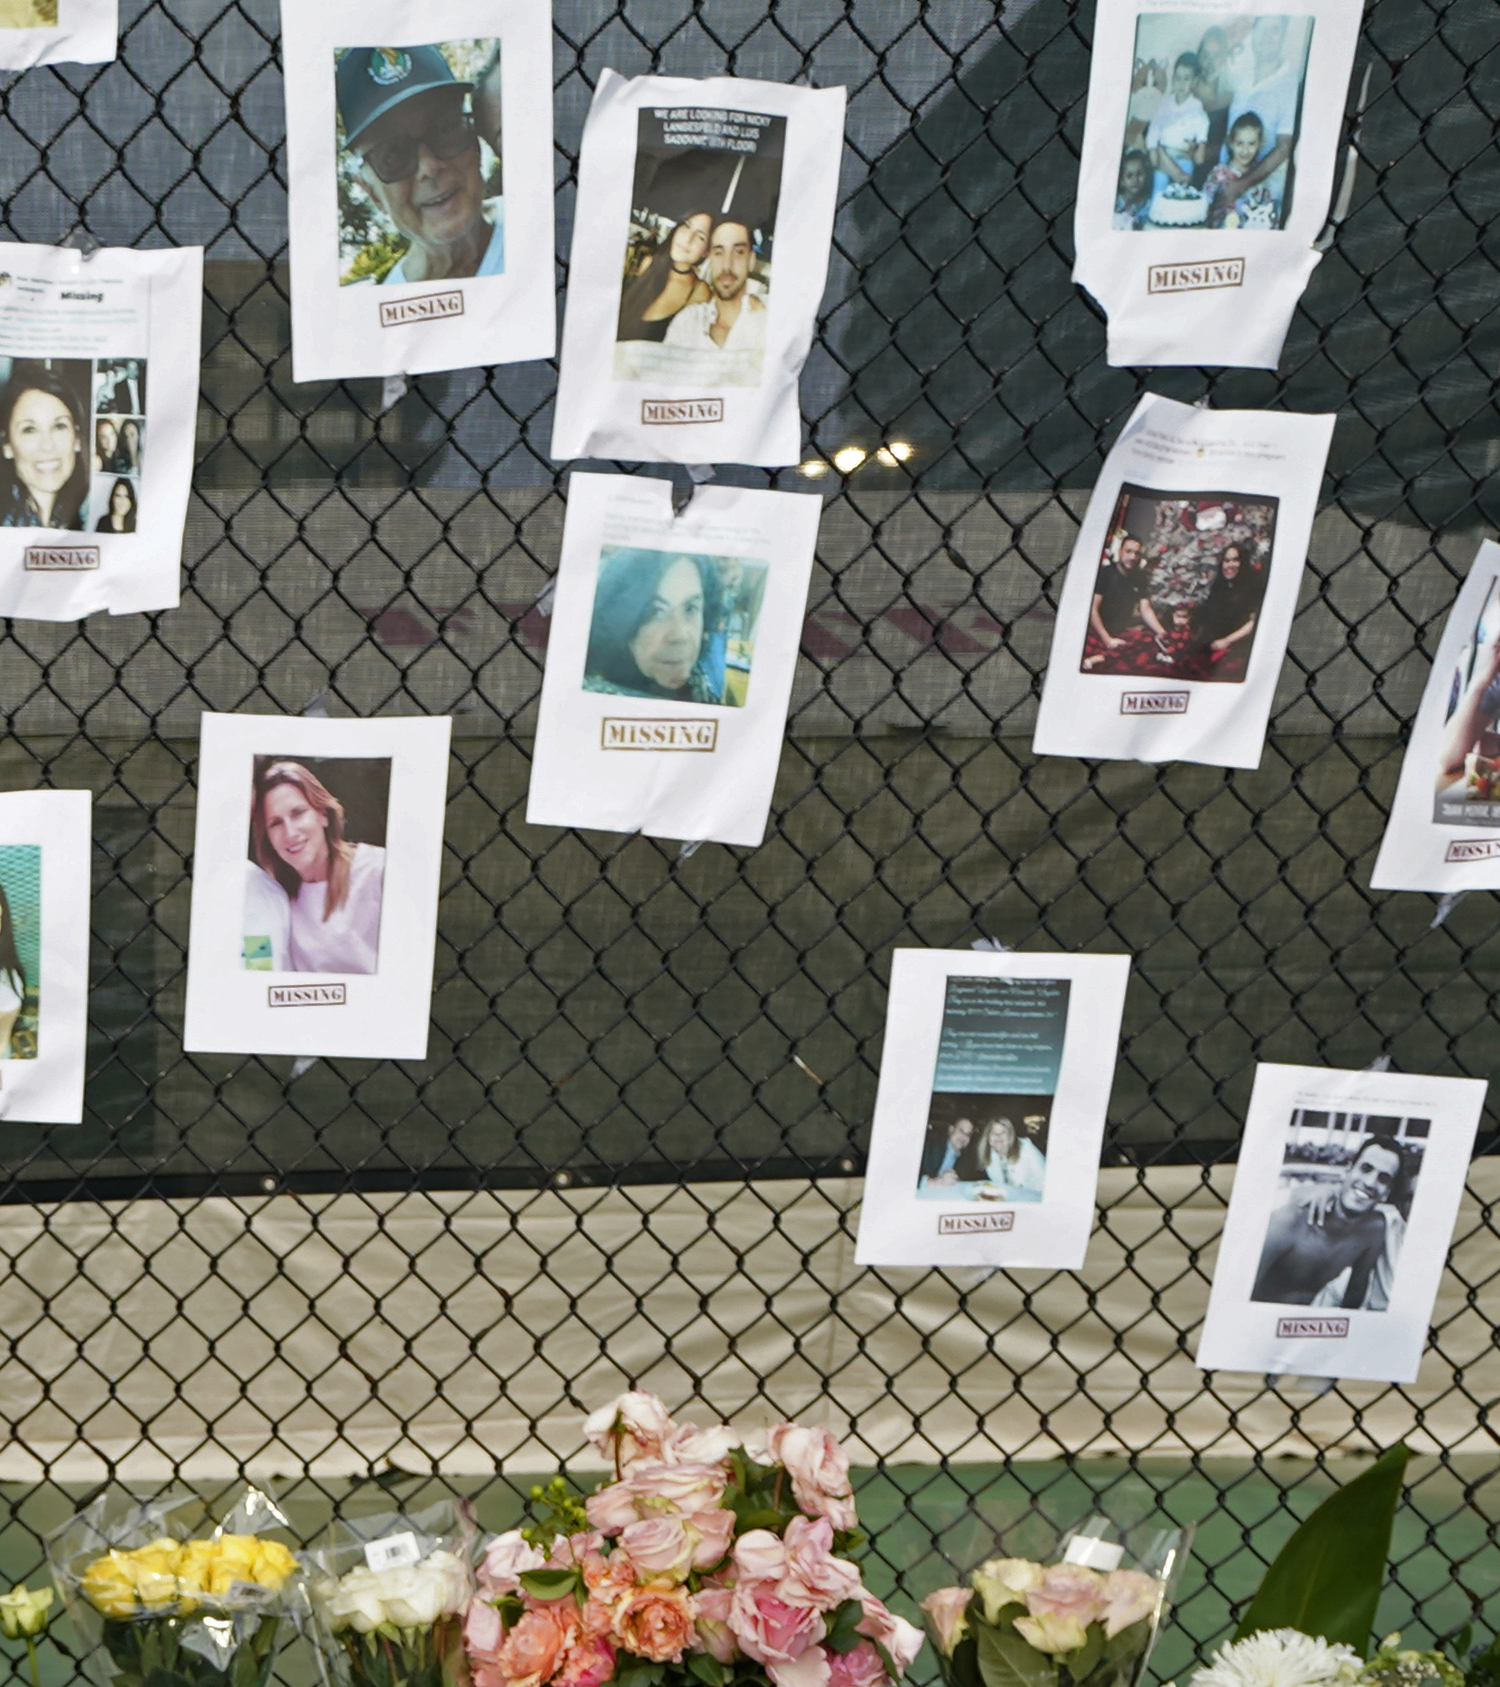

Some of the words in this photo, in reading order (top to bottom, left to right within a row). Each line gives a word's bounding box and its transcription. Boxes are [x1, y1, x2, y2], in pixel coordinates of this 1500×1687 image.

[1152, 261, 1241, 289] MISSING
[60, 291, 104, 303] Missing
[383, 295, 460, 322] MISSING
[645, 402, 720, 421] MISSING
[27, 549, 96, 567] MISSING
[1124, 694, 1186, 711] MISSING
[608, 722, 713, 746] MISSING
[271, 987, 344, 1004] MISSING
[942, 1214, 1010, 1231] MISSING
[1280, 1320, 1346, 1335] MISSING
